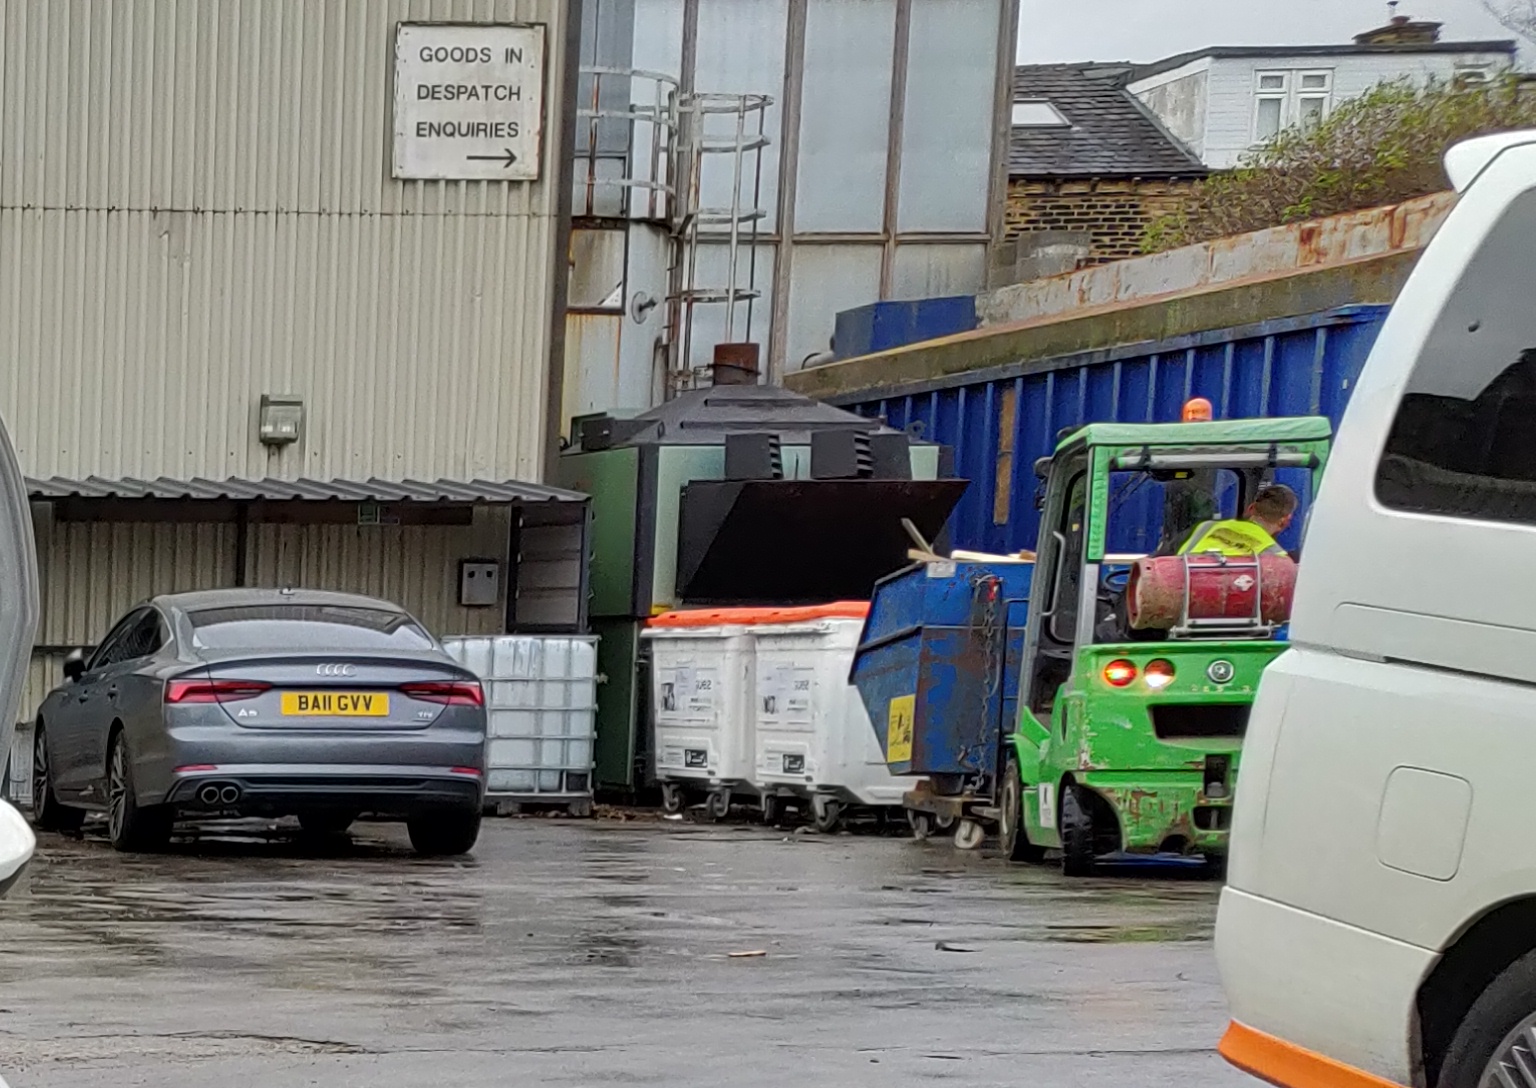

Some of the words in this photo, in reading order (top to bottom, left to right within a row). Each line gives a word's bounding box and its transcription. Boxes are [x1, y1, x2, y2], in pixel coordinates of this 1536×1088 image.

[419, 46, 492, 63] GOODS
[505, 47, 523, 64] IN
[417, 84, 521, 101] DESPATCH
[416, 121, 520, 139] ENQUIRIES
[337, 694, 373, 711] GVV
